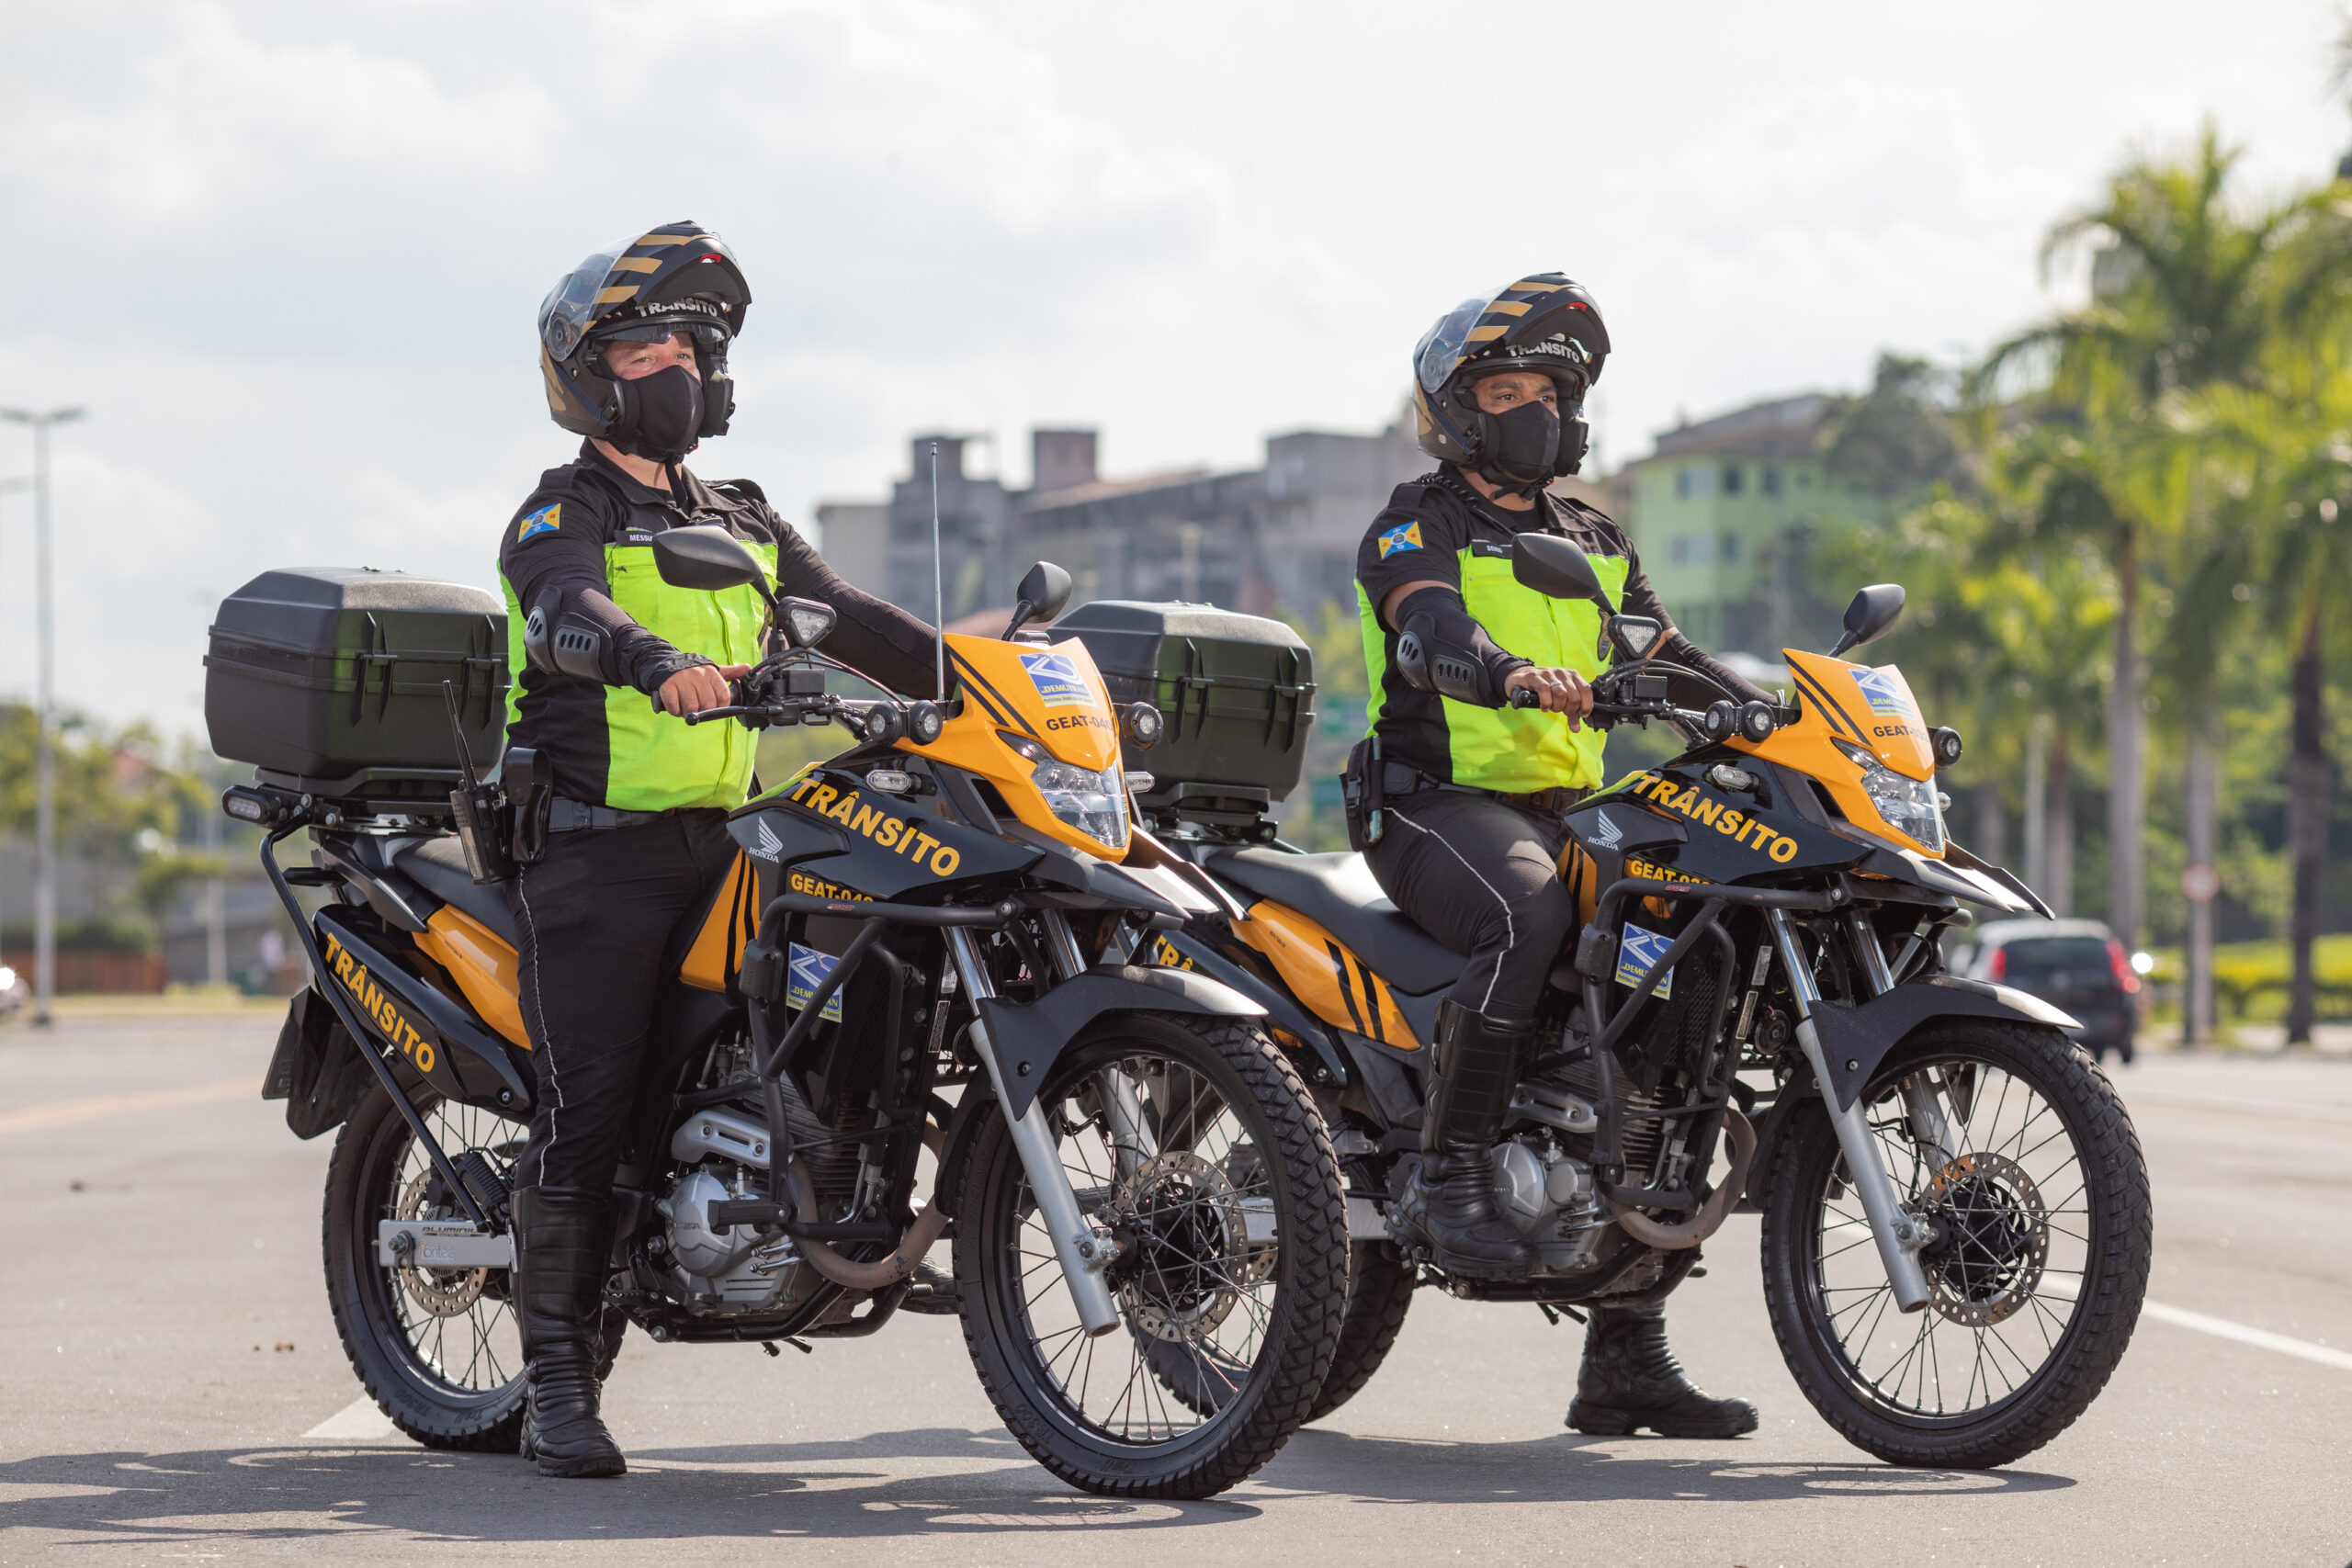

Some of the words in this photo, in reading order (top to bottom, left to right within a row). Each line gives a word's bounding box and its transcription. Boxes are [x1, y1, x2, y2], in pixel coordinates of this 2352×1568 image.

[749, 846, 780, 863] HONDA
[791, 777, 960, 877] TRÂNSITO
[1588, 836, 1619, 851] HONDA
[1634, 774, 1798, 863] TRÂNSITO
[325, 932, 435, 1073] TRÂNSITO
